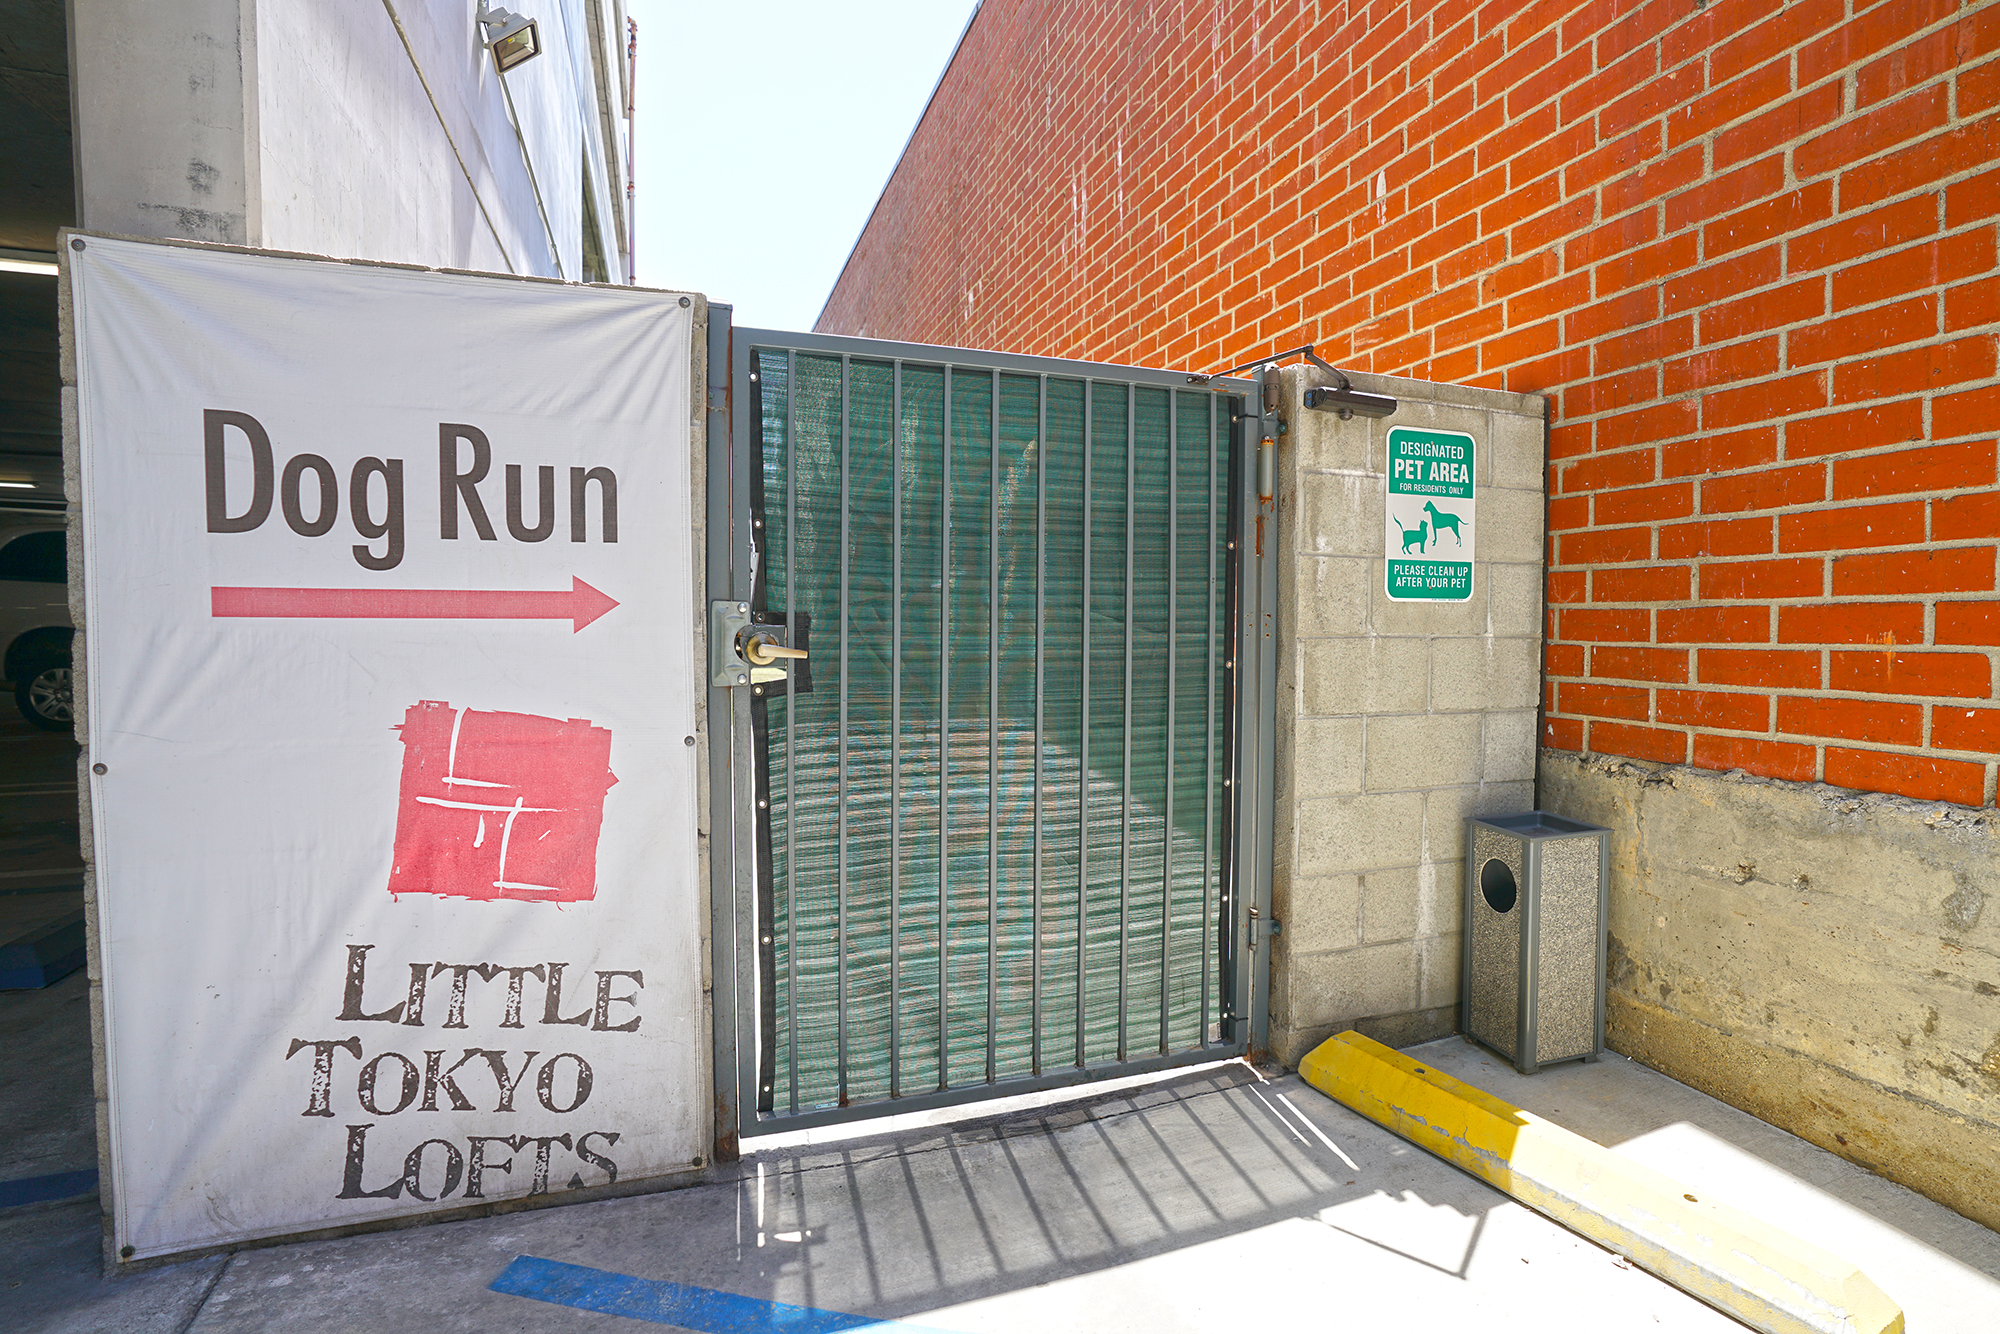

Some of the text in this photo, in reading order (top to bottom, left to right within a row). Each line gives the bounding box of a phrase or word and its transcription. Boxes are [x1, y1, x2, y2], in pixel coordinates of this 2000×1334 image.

[1400, 441, 1464, 460] DESIGNATED
[1394, 458, 1470, 484] PET AREA
[202, 408, 619, 571] Dog Run
[1399, 482, 1464, 495] FOR RESIDENTS ONLY
[1394, 564, 1469, 577] PLEASE CLEAN UP
[1395, 577, 1466, 589] AFTER YOUR PET
[335, 944, 644, 1033] LITTLE
[285, 1035, 593, 1118] TOKYO
[335, 1123, 621, 1202] LOFTS
